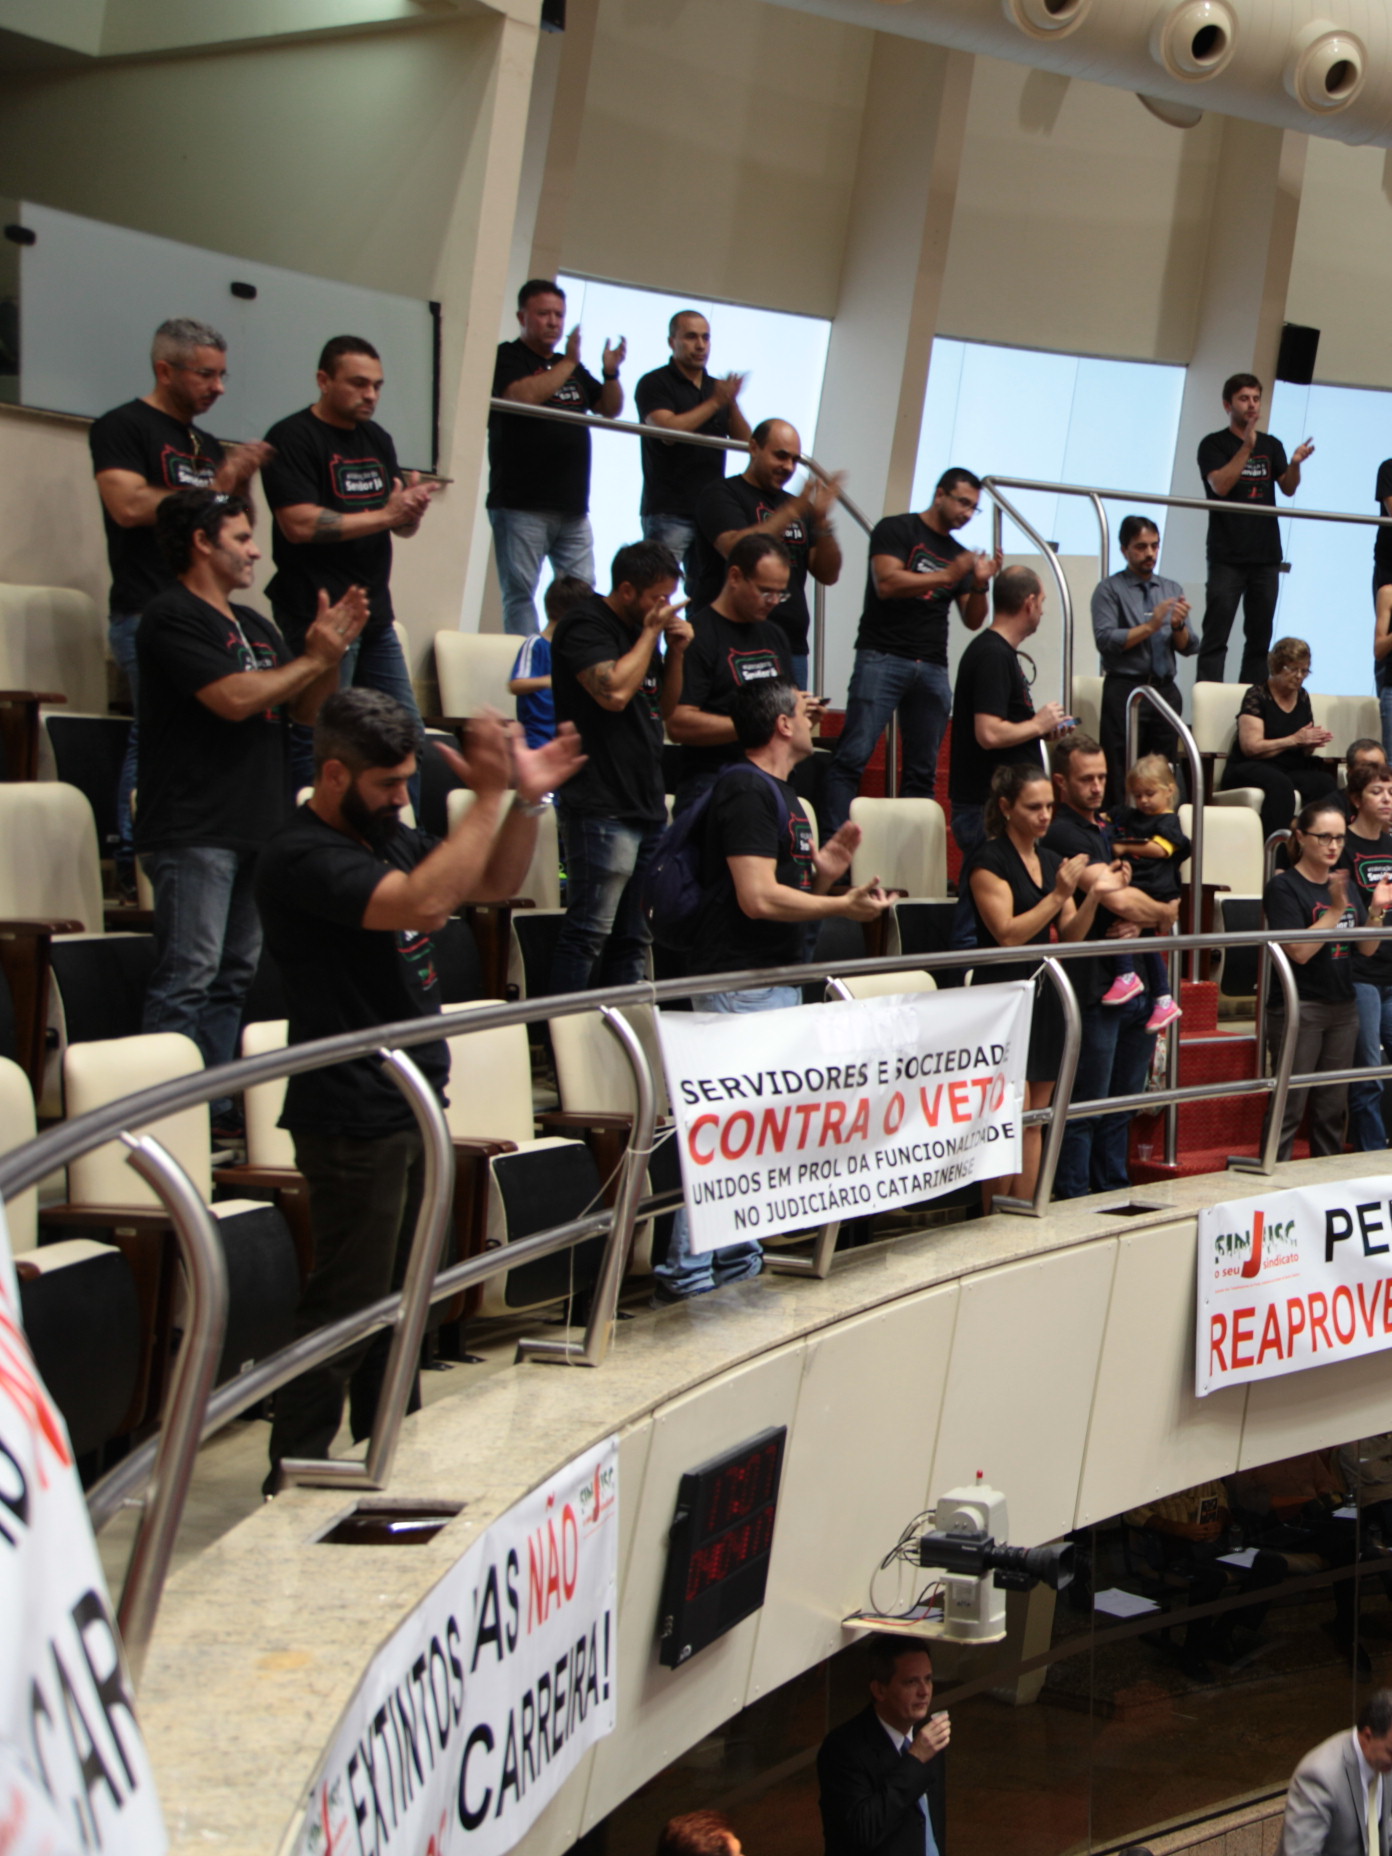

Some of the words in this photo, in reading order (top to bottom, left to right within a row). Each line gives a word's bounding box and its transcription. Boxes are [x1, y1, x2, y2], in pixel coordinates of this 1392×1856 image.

[680, 1062, 868, 1105] SERVIDORES
[878, 1060, 889, 1085] E
[687, 1098, 869, 1165] CONTRA
[883, 1091, 905, 1136] O
[920, 1072, 1006, 1128] VETO
[693, 1172, 762, 1205] UNIDOS
[768, 1167, 791, 1189] EM
[799, 1157, 841, 1183] PROL
[847, 1153, 871, 1174] DA
[876, 1122, 1015, 1168] FUNCIONALIDADE
[734, 1208, 760, 1230] NO
[767, 1183, 872, 1223] JUDICIÁRIO
[876, 1158, 976, 1199] CATARINENSE
[1222, 1266, 1240, 1277] seu
[1263, 1253, 1299, 1270] sindicato
[346, 1615, 465, 1856] EXTINTOS
[527, 1490, 578, 1636] NÃO
[457, 1611, 612, 1832] CARREIRA!
